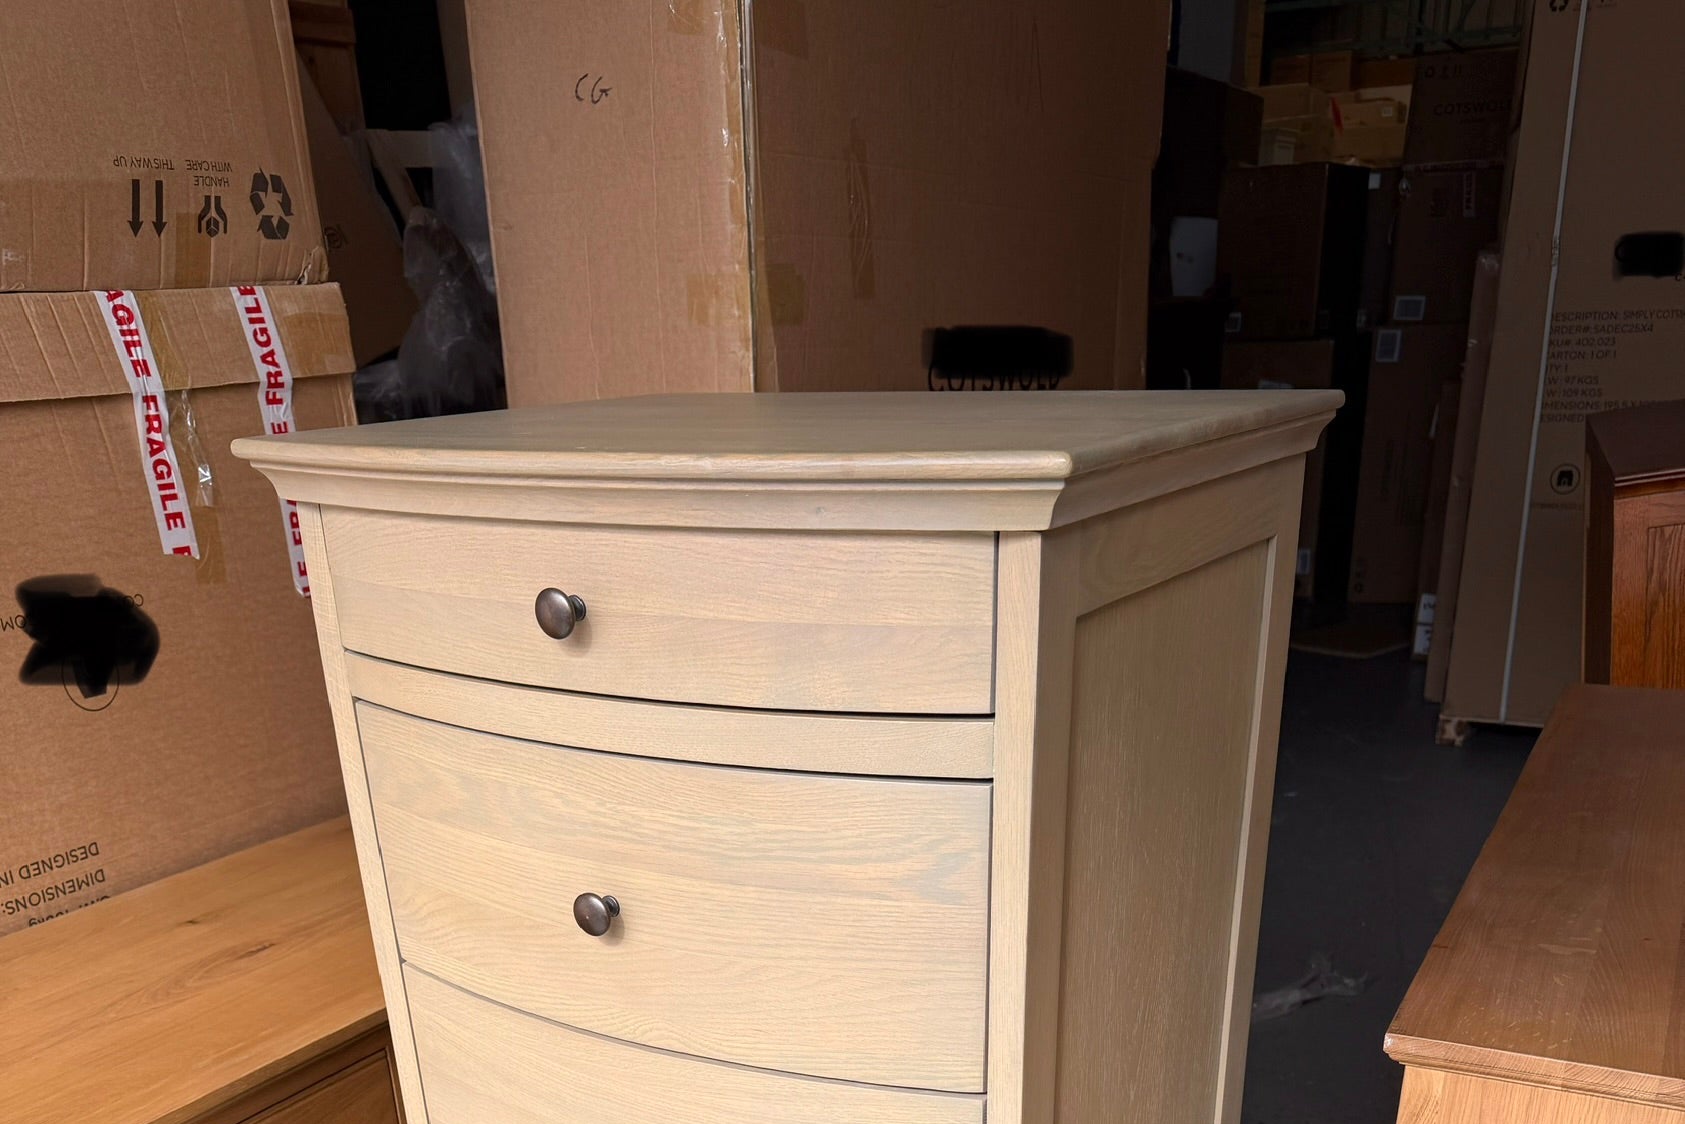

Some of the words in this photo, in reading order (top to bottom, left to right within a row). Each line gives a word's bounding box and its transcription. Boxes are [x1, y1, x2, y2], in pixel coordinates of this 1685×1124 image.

[112, 155, 127, 167] UP
[130, 156, 153, 170] WAY
[154, 158, 175, 171] THIS
[185, 159, 210, 171] CARE
[212, 160, 233, 172] WITH
[193, 175, 230, 188] HANDLE
[1551, 311, 1620, 322] ESCRIPTION:
[106, 289, 152, 378] AGILE
[237, 285, 286, 406] FRAGILE
[1547, 350, 1587, 360] ARTON:
[142, 394, 186, 531] FRAGILE
[18, 841, 100, 880] DESIGNED
[0, 868, 106, 915] DIMENSIONS:
